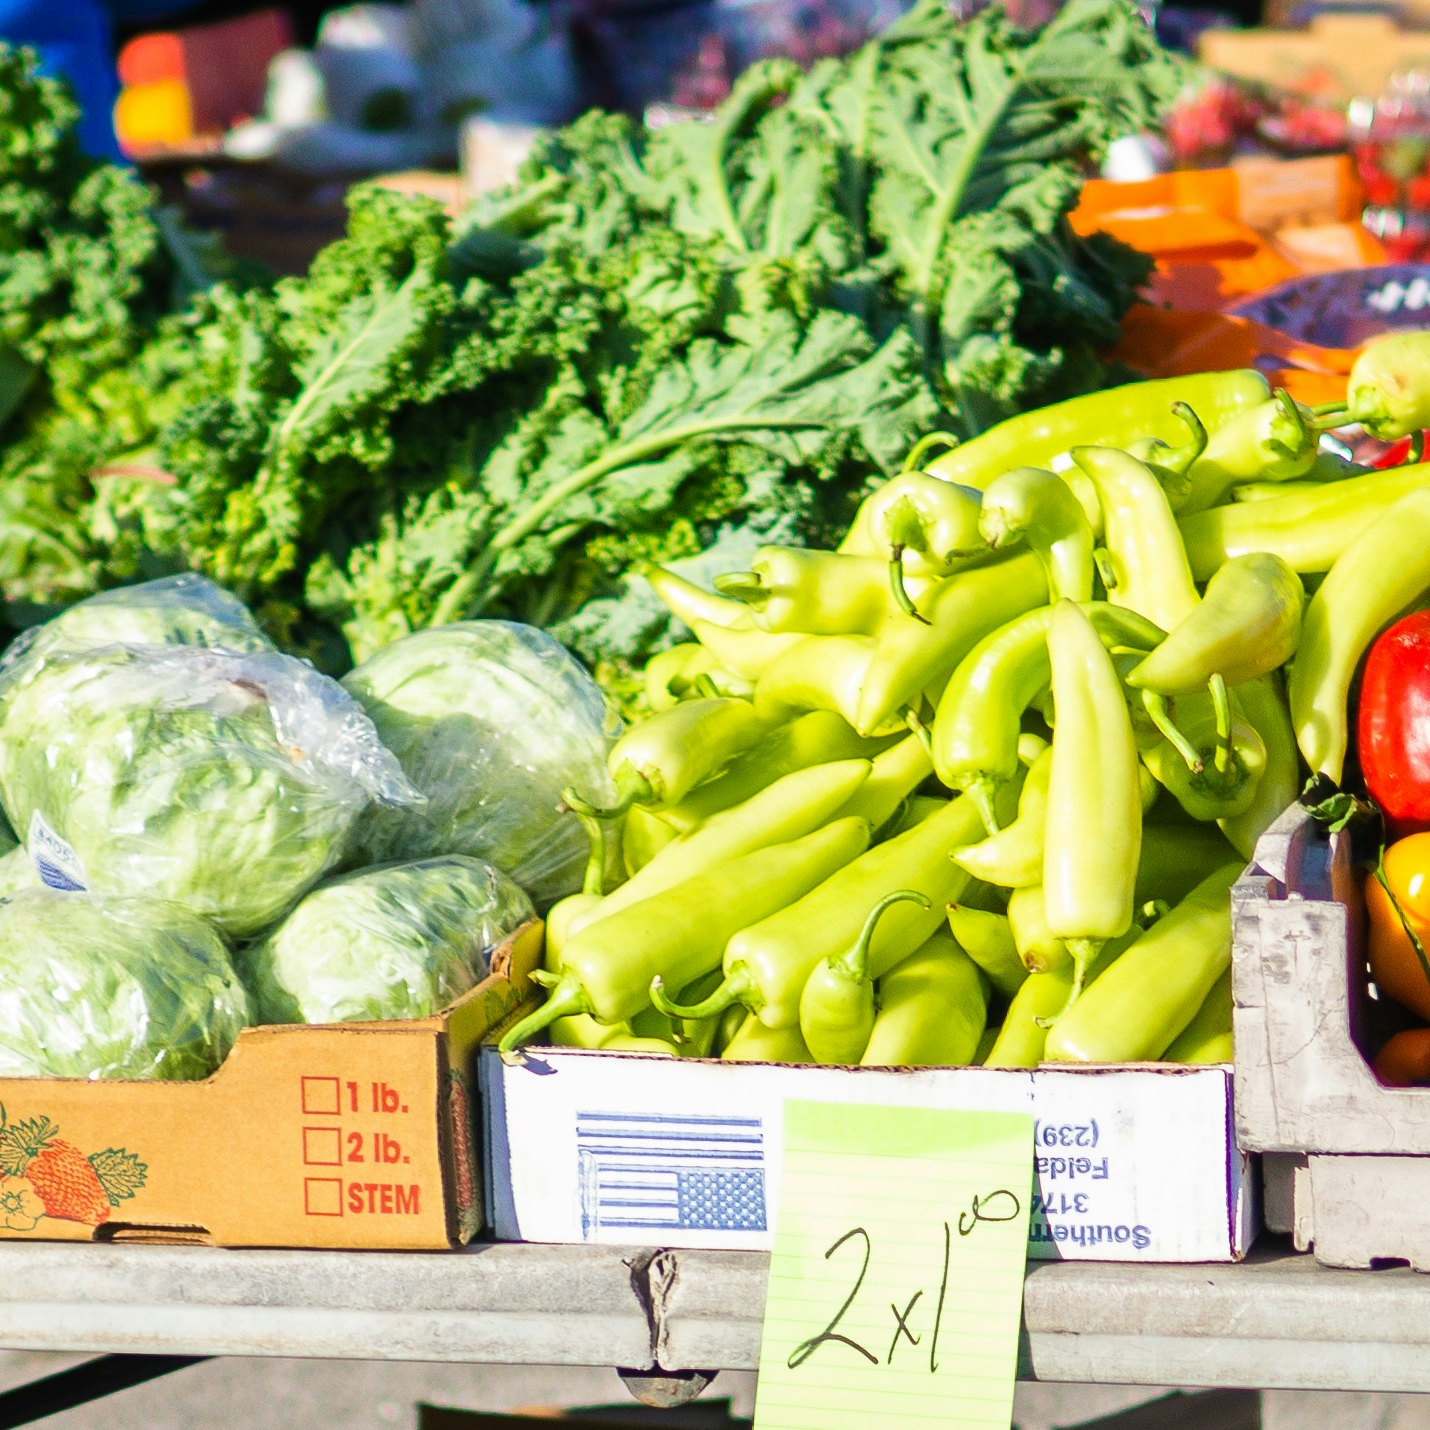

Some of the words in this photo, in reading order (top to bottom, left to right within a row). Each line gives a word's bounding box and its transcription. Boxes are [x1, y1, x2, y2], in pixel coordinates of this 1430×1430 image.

[346, 1081, 359, 1113] 1
[371, 1081, 409, 1114] lb.
[346, 1131, 365, 1164] 2
[373, 1133, 410, 1164] lb.
[1034, 1117, 1100, 1148] (239)
[1034, 1156, 1109, 1180] Felda
[347, 1182, 421, 1216] STEM
